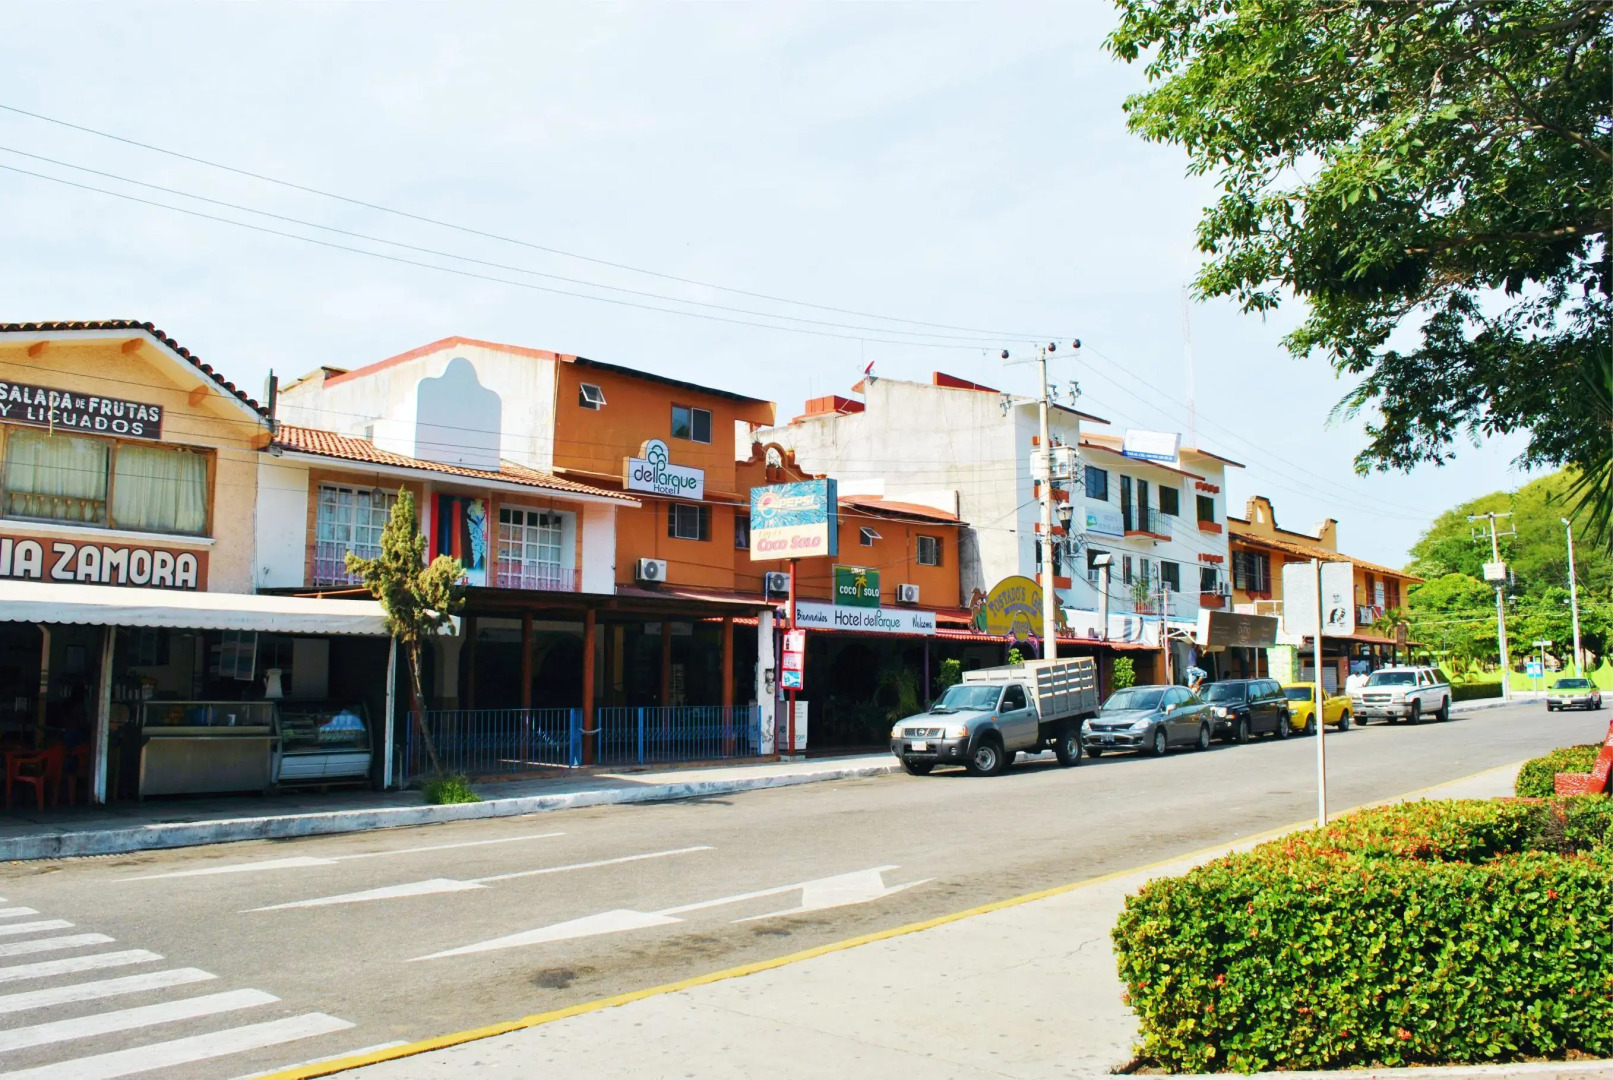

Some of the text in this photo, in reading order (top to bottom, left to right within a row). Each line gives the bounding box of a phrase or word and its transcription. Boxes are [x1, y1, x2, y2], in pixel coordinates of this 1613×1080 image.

[0, 382, 159, 422] SALADA DE FRUTAS
[0, 402, 143, 435] Y LICUADOS
[653, 484, 676, 495] Hotel
[50, 541, 198, 590] ZAMORA
[839, 585, 880, 597] COCO SOLO
[796, 608, 828, 622] Bienvenidos
[834, 609, 862, 626] Hotel
[912, 614, 933, 629] Welcome
